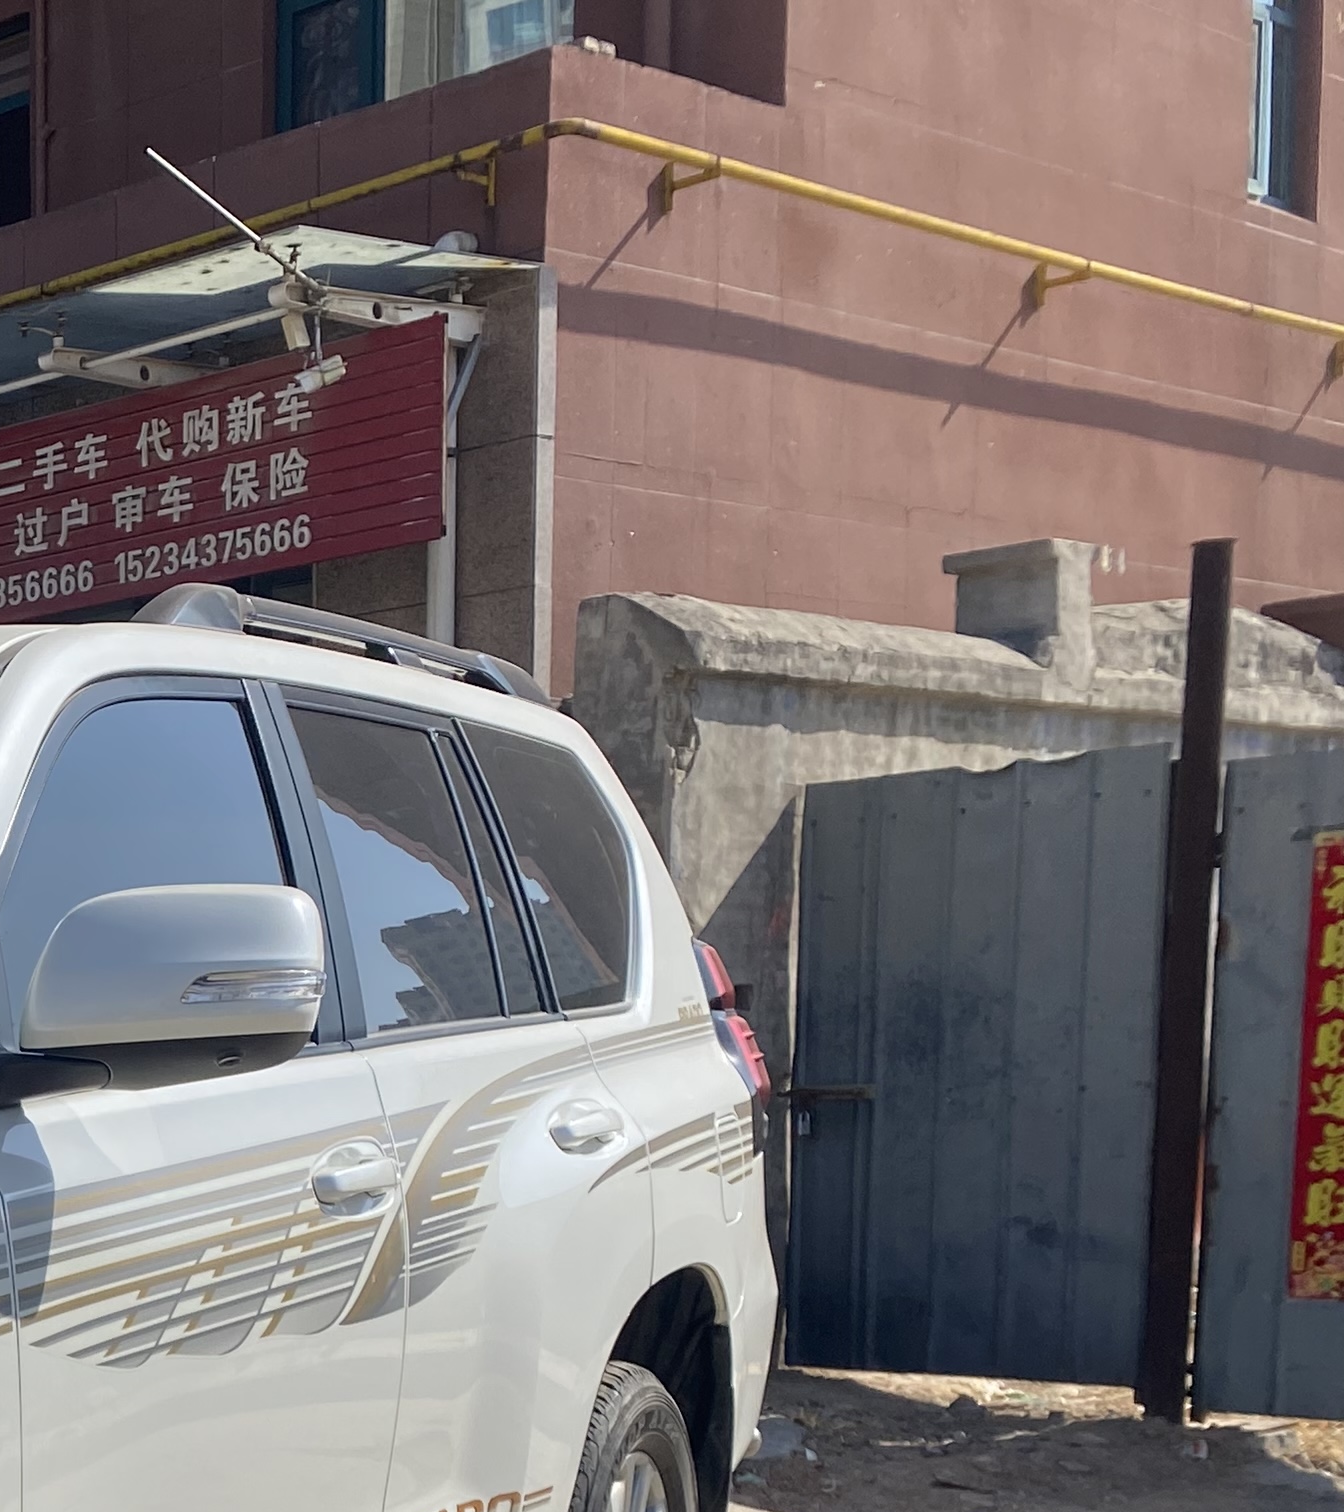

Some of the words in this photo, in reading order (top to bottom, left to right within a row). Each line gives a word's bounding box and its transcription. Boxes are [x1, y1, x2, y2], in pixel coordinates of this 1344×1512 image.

[137, 382, 313, 467] 代购新车
[14, 499, 90, 556] 过户
[112, 476, 194, 532] 审车
[221, 447, 310, 511] 保险
[114, 514, 311, 584] 15234375666
